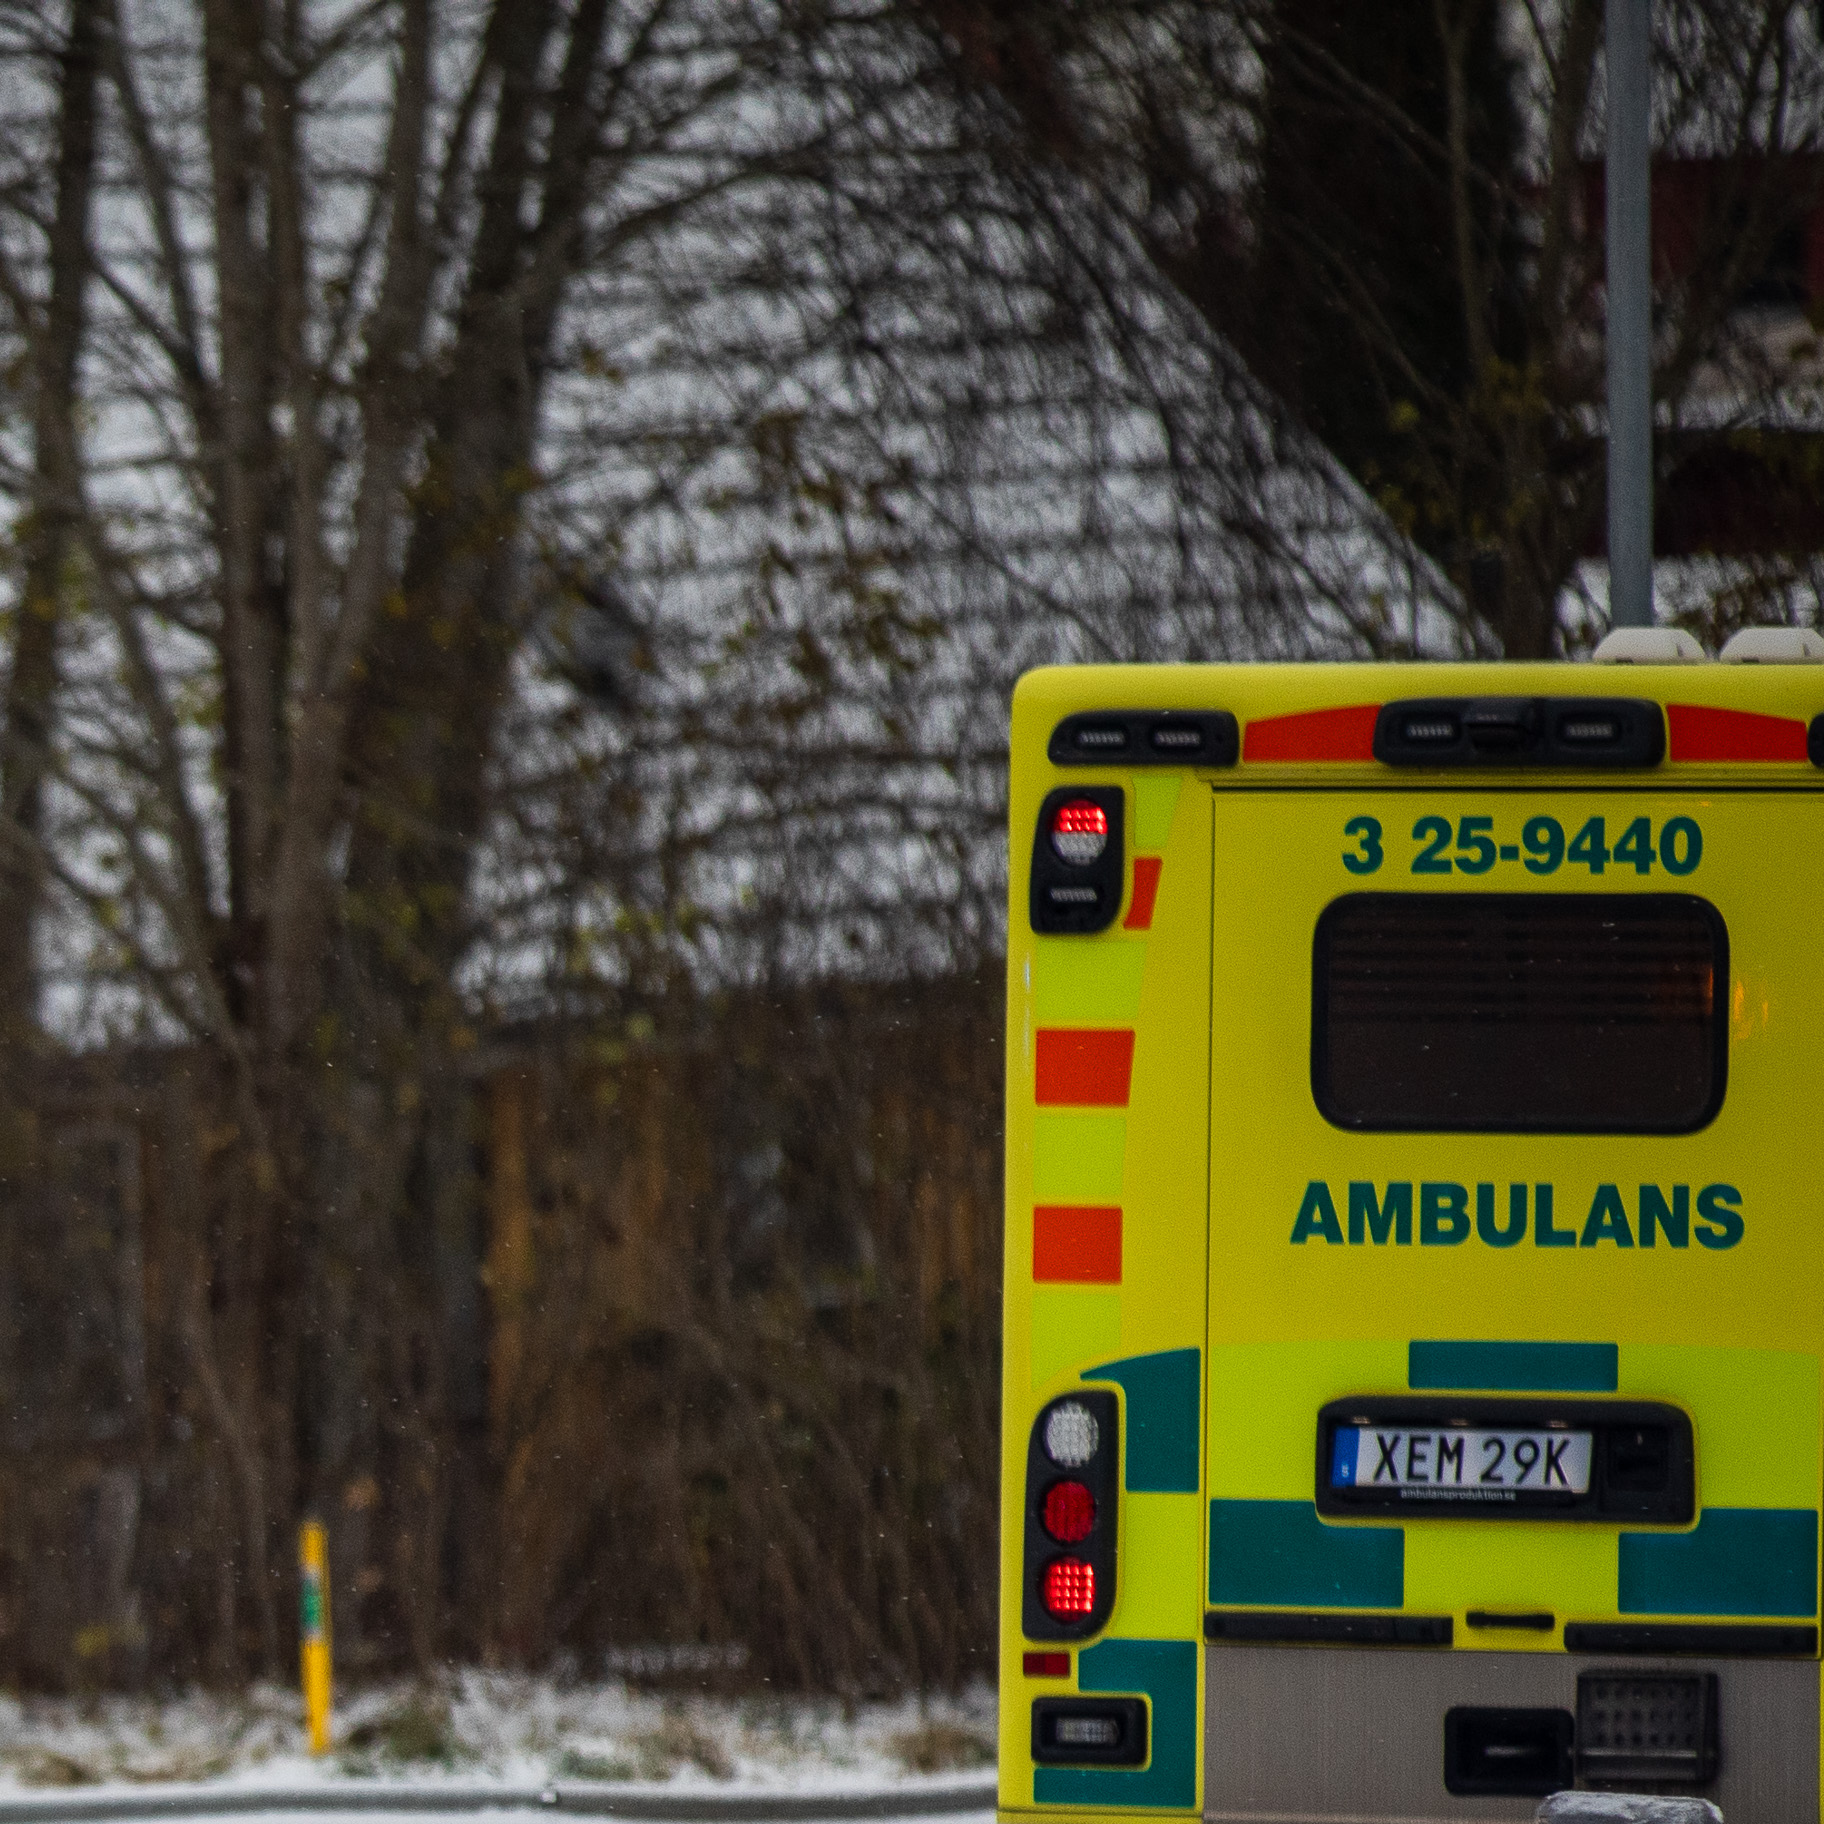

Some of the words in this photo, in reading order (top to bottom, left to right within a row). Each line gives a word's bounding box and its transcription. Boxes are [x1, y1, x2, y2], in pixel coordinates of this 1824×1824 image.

[1342, 815, 1384, 875] 3
[1410, 815, 1704, 876] 25-9440
[1289, 1179, 1746, 1250] AMBULANS
[1372, 1433, 1465, 1483] XEM
[1479, 1437, 1570, 1486] 29K
